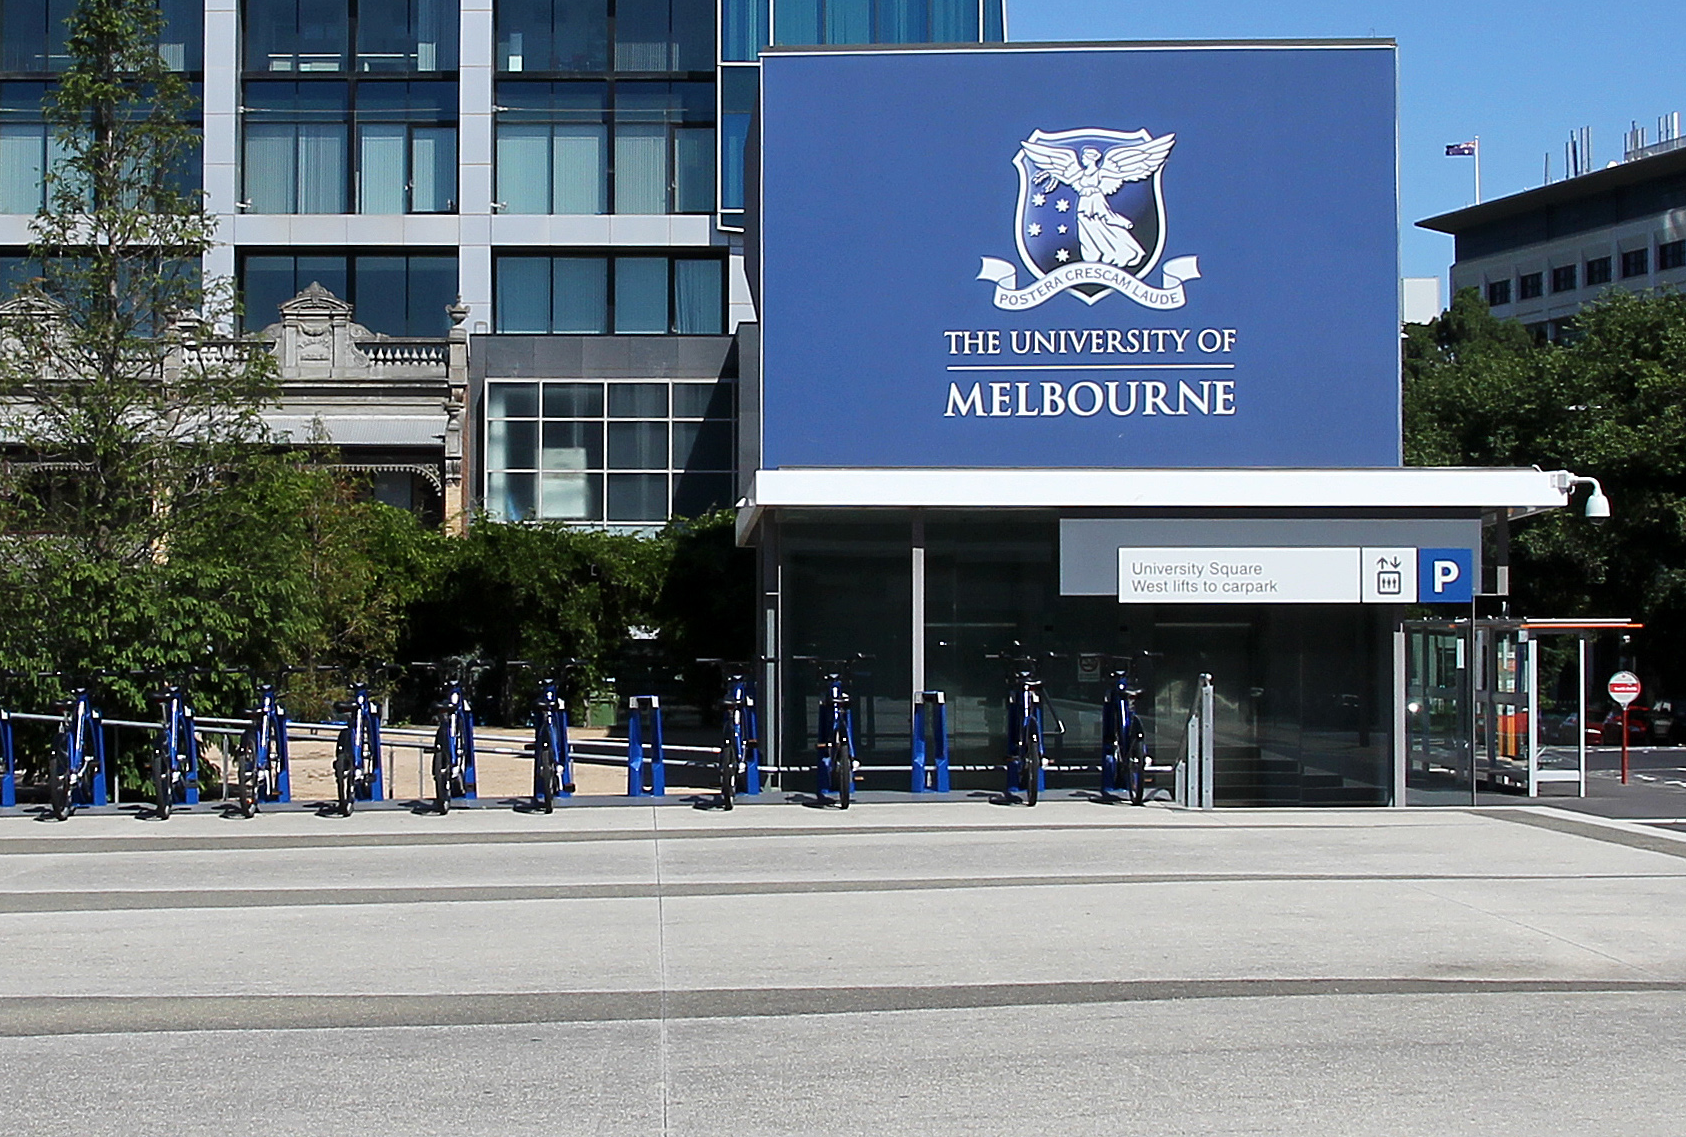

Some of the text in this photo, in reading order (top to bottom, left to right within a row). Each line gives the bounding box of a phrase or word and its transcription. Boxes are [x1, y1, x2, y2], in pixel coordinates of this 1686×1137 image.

[999, 266, 1181, 306] POSTERA CRESCAM LAUDE
[944, 328, 1237, 355] THE UNIVERSITY OF
[943, 380, 1237, 417] MELBOURNE
[1132, 562, 1262, 578] University Square
[1433, 560, 1460, 593] P
[1132, 580, 1278, 596] West lifts to carpark
